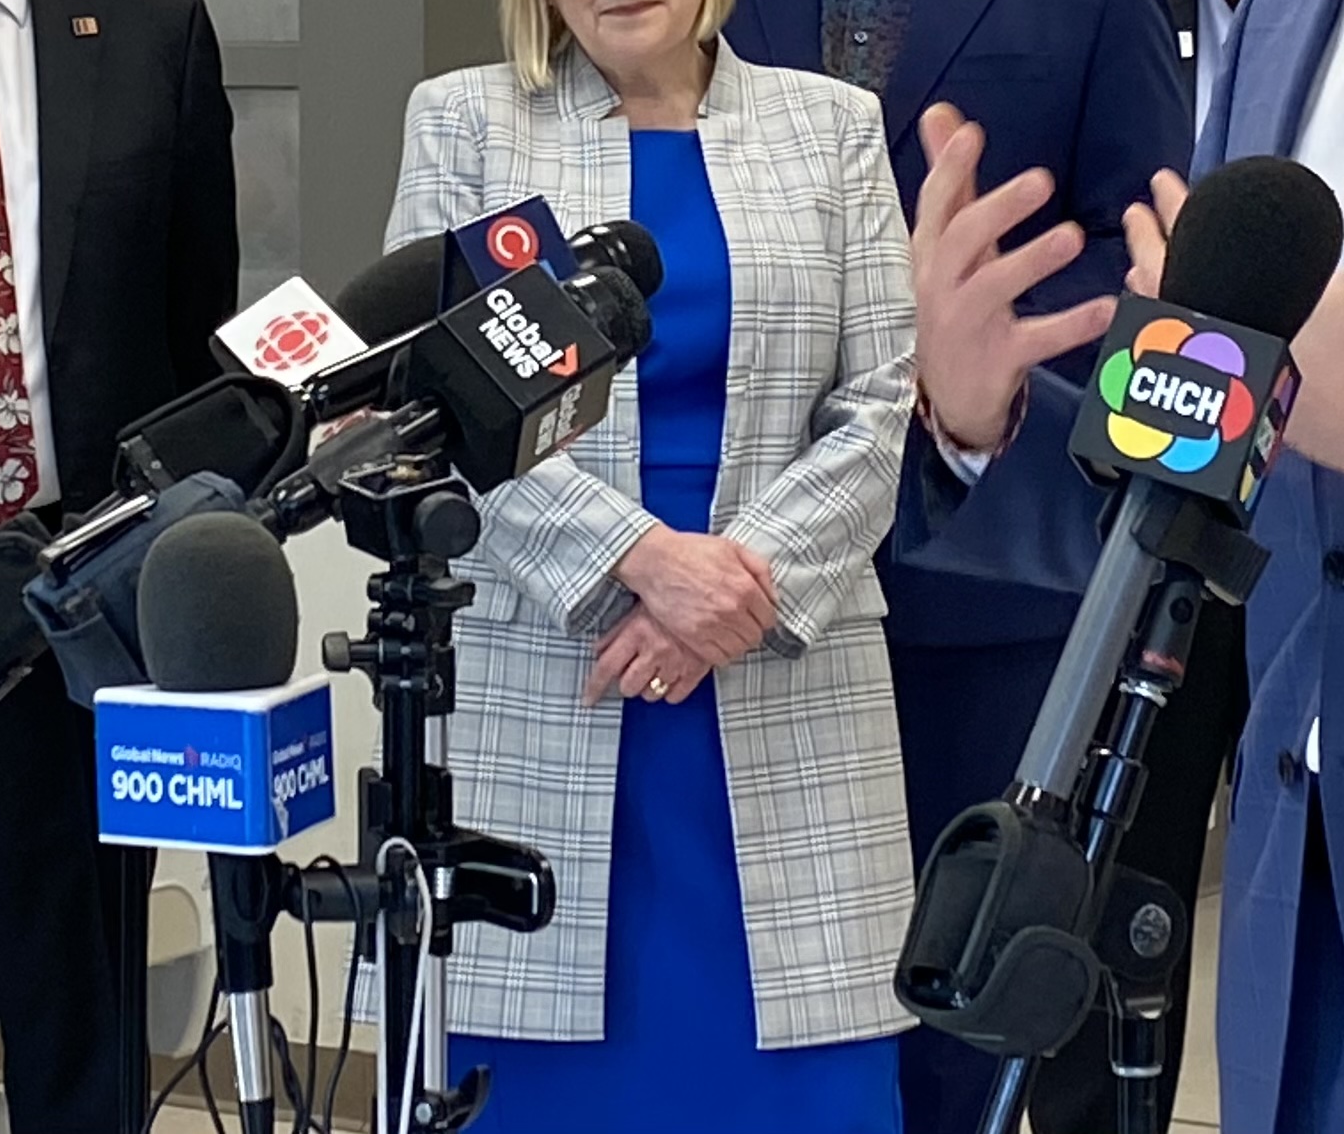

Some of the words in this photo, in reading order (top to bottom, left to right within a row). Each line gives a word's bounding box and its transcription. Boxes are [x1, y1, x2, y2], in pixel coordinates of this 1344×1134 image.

[478, 317, 540, 379] NEWS
[486, 288, 564, 368] Global
[1129, 366, 1225, 426] CHCH
[111, 770, 163, 803] 900
[168, 773, 244, 810] CHML
